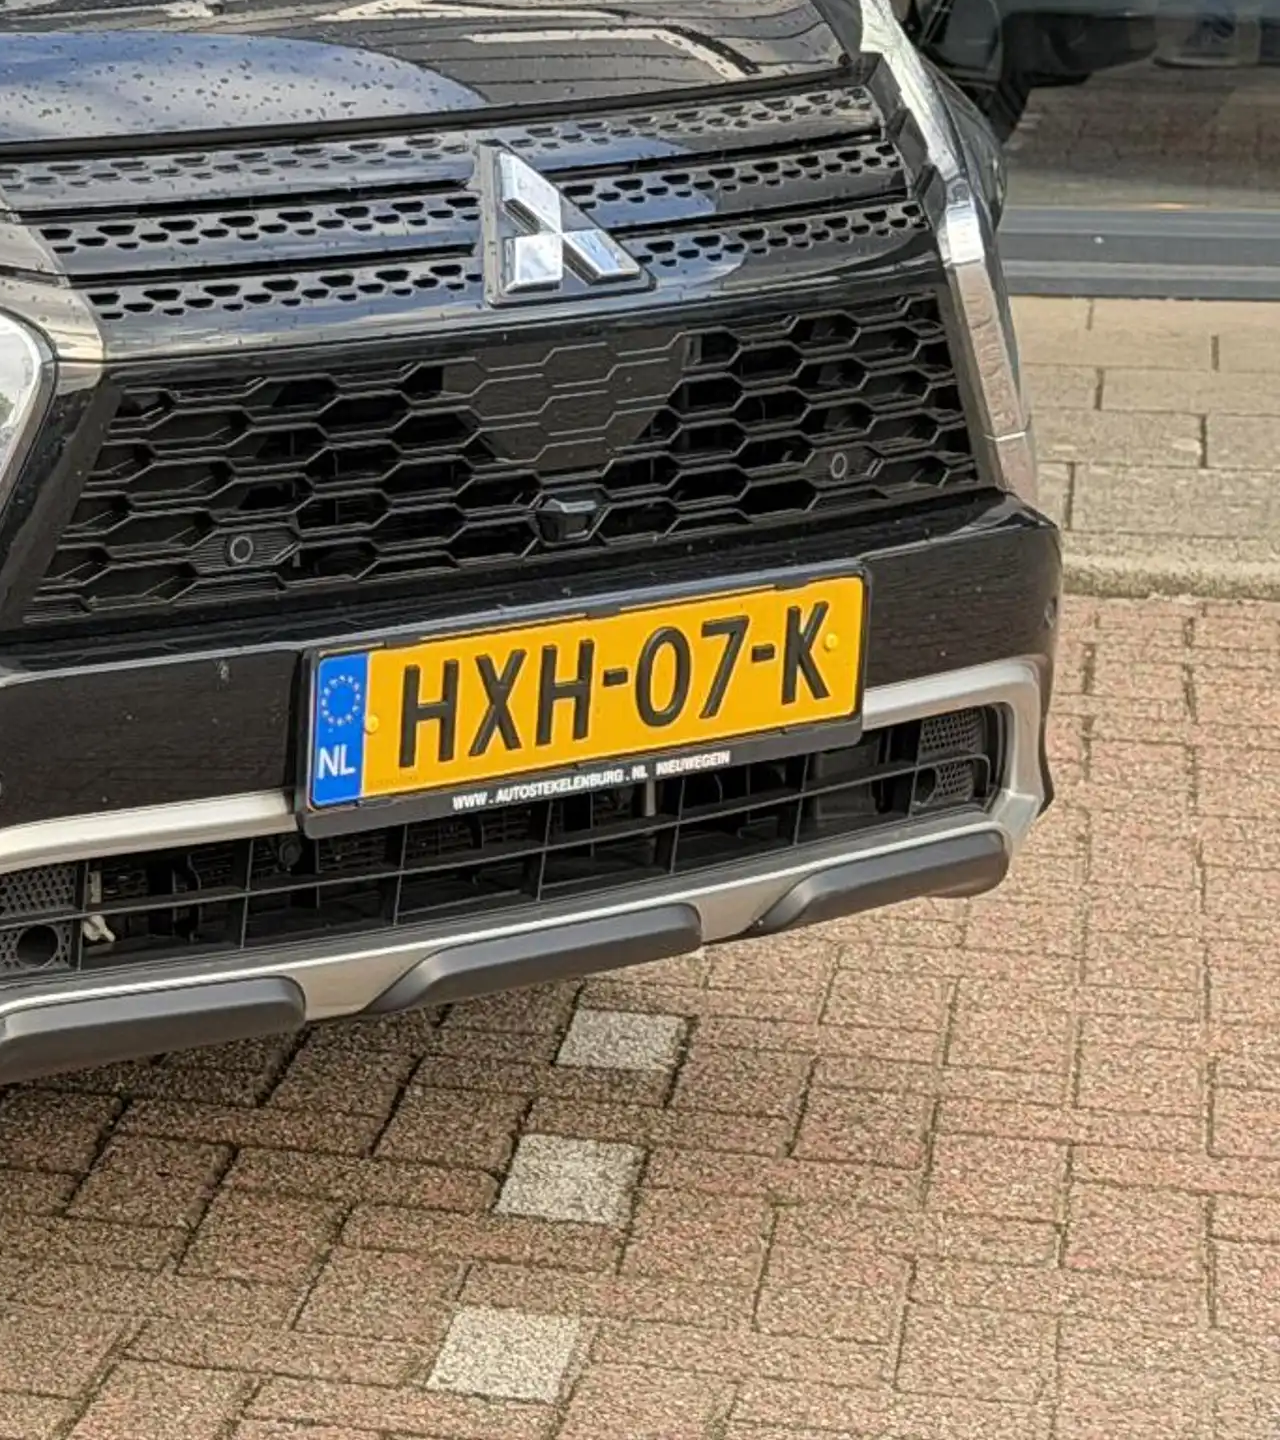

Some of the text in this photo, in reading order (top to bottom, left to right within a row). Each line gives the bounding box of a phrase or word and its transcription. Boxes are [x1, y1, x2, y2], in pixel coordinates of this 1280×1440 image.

[398, 601, 830, 768] HXH-07-K
[317, 743, 356, 780] NL
[656, 750, 731, 776] NIEUWEGEIN
